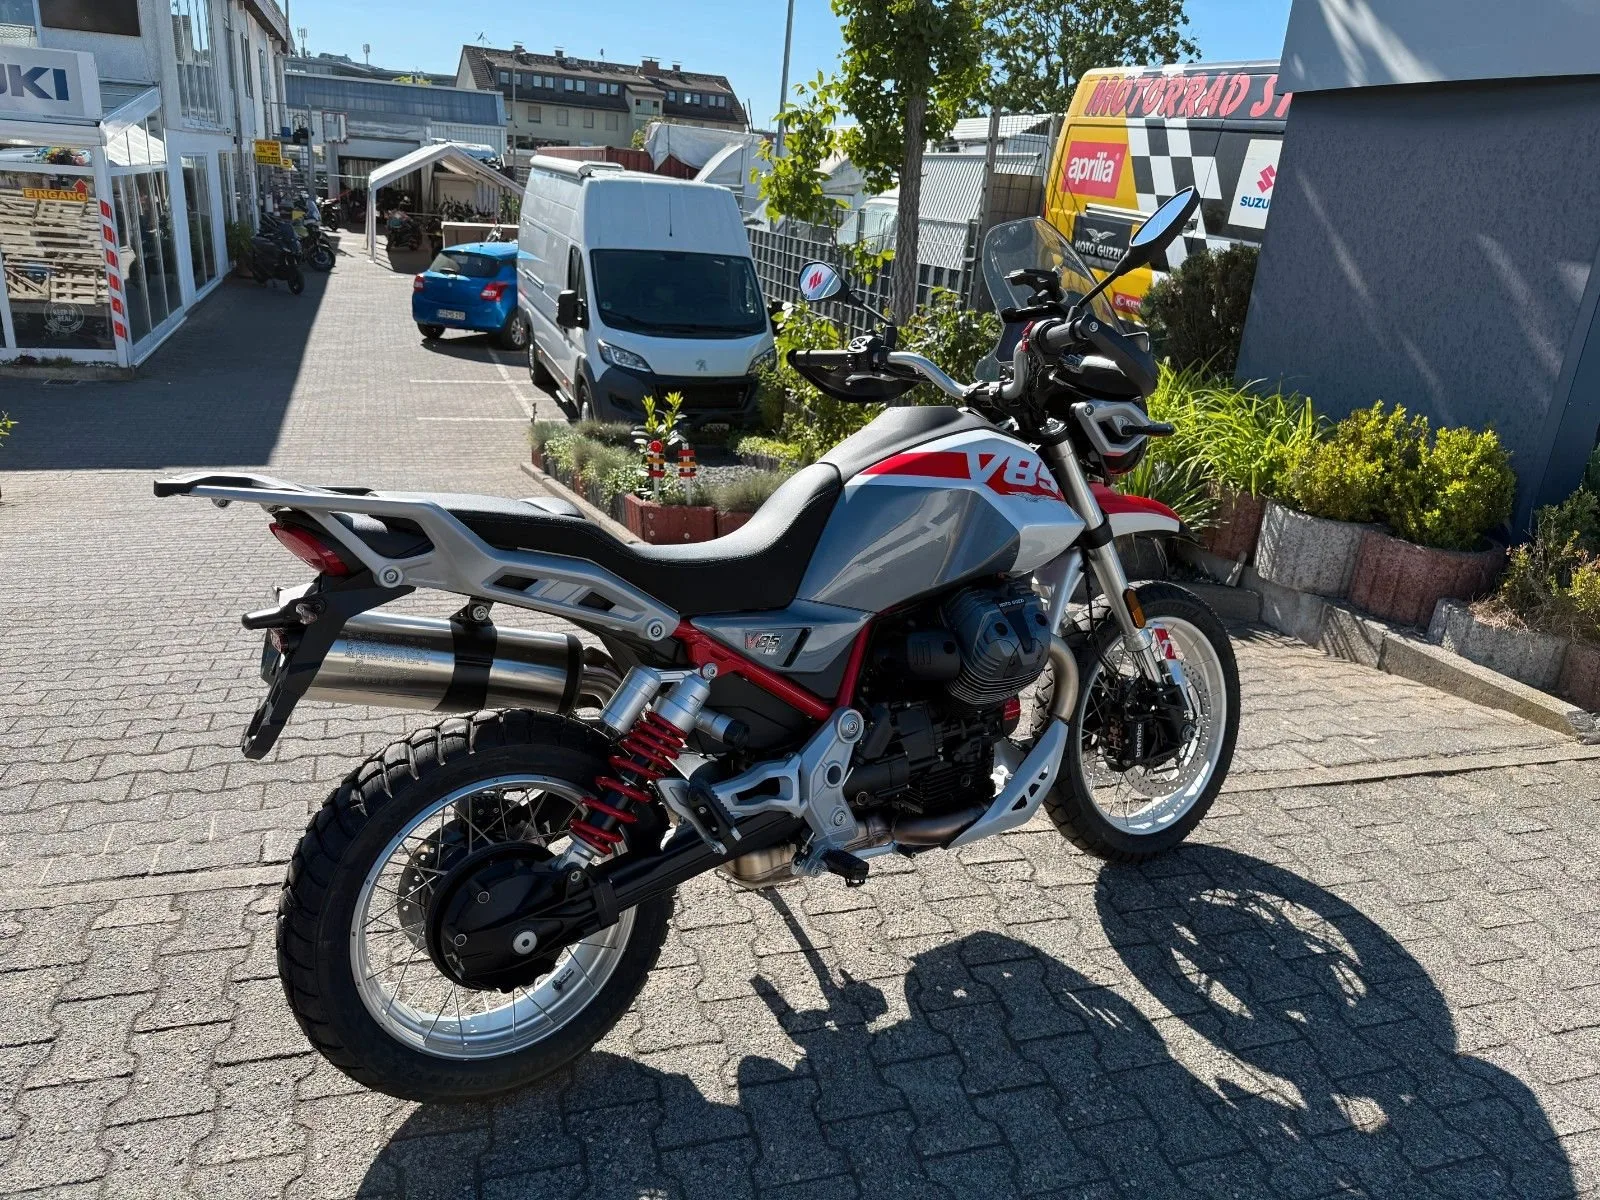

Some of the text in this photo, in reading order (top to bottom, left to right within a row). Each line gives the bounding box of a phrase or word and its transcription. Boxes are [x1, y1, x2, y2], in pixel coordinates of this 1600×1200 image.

[1084, 72, 1250, 117] MOTORRAD
[1068, 152, 1115, 184] aprilia
[24, 189, 86, 200] EINGANG
[1074, 239, 1122, 260] MOTO GUZZI
[744, 632, 781, 649] V85
